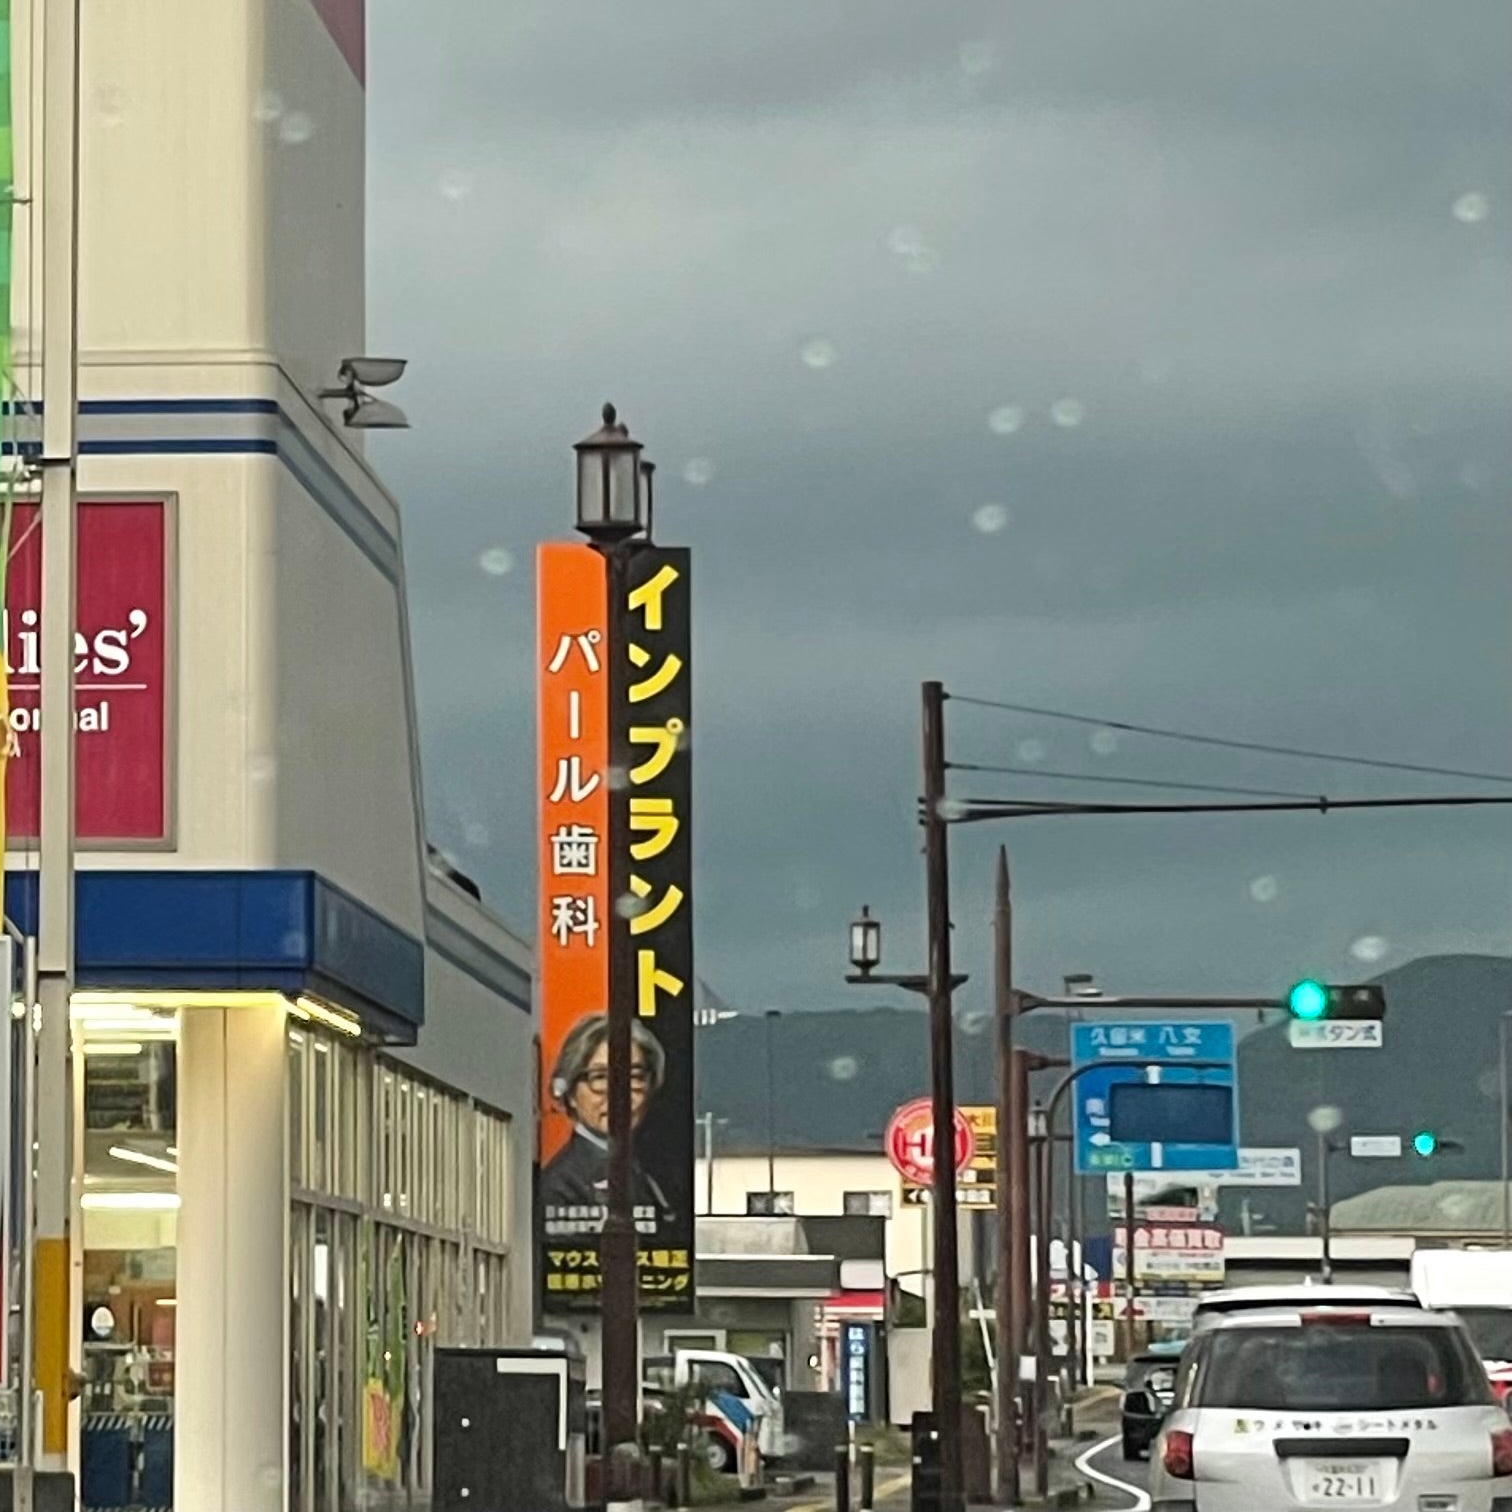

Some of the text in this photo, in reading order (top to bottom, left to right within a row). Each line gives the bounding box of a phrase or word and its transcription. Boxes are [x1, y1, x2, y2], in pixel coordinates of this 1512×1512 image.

[548, 629, 601, 948] パール歯科
[628, 563, 684, 1018] インプラント
